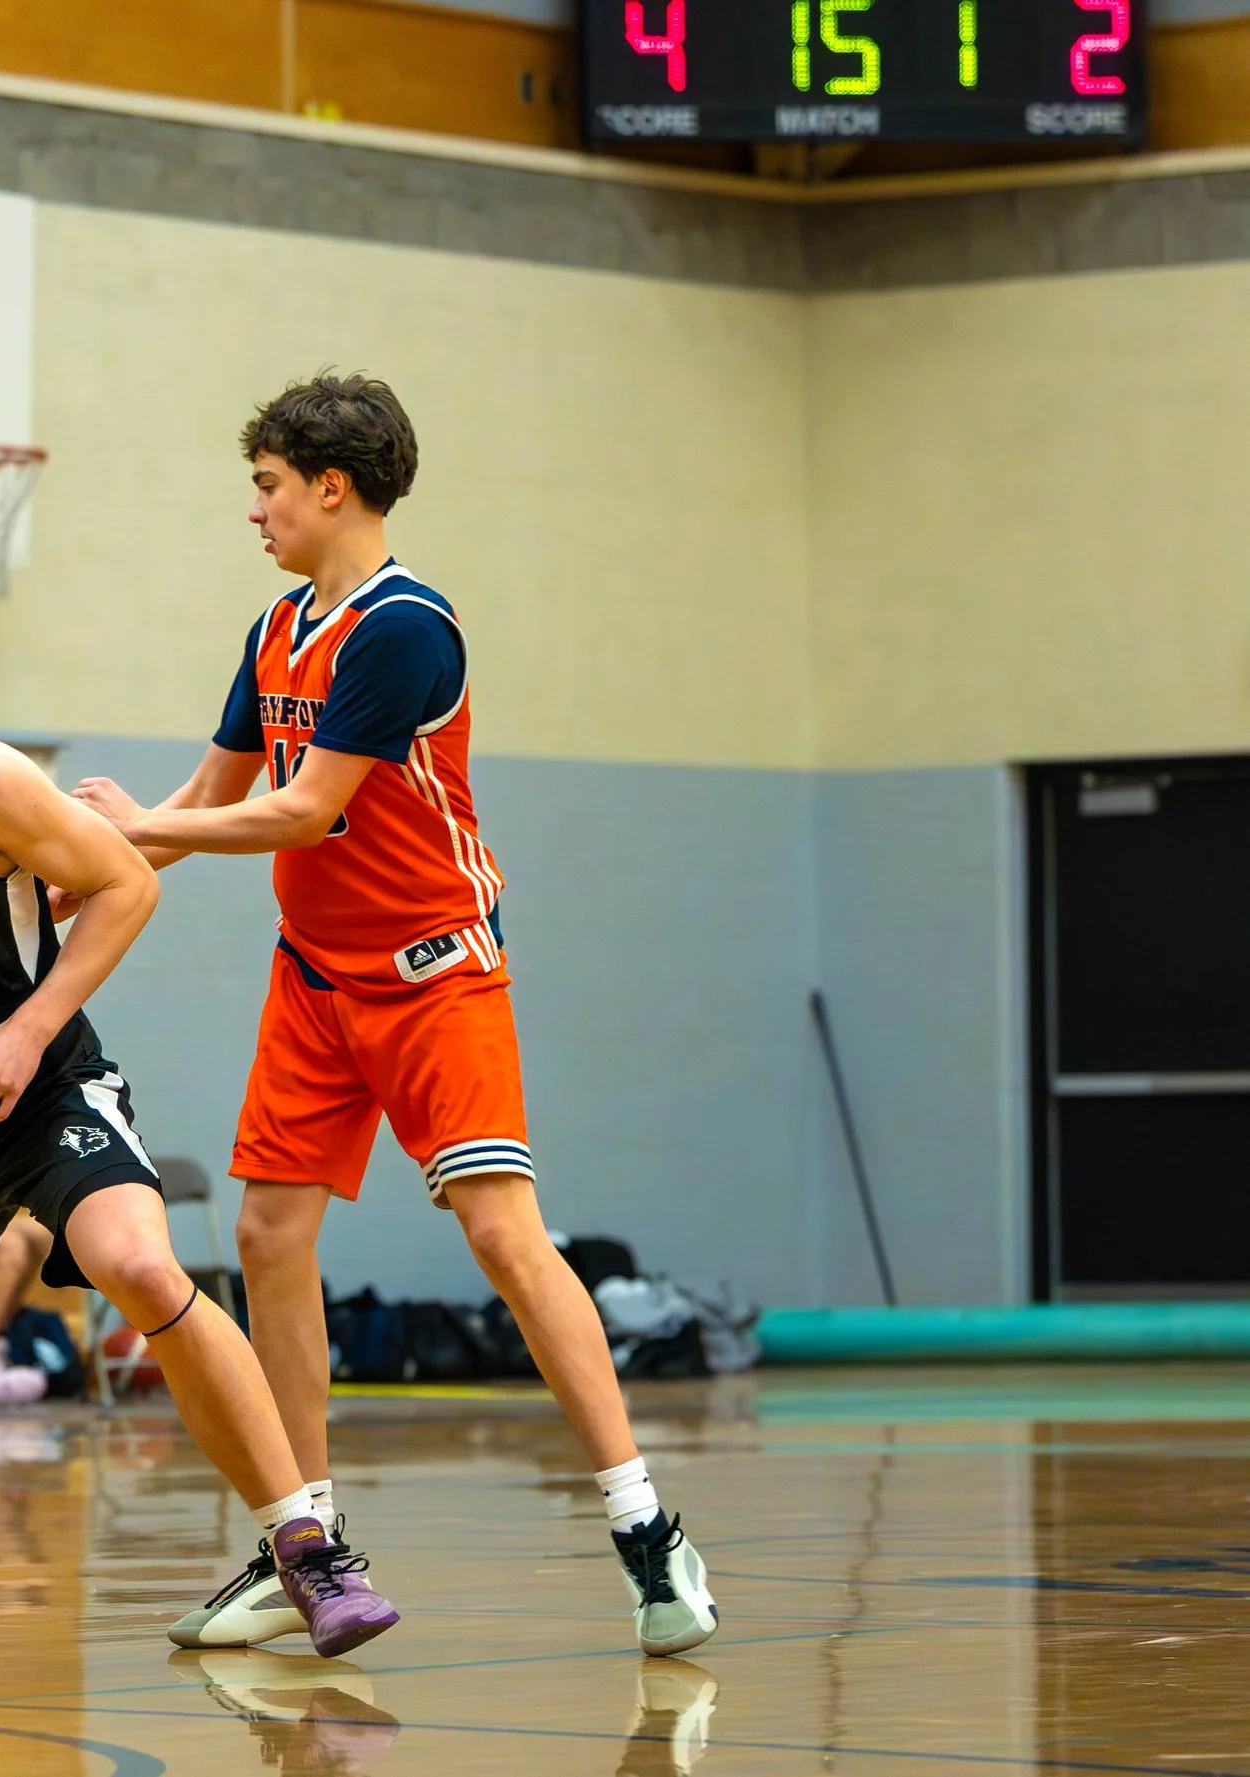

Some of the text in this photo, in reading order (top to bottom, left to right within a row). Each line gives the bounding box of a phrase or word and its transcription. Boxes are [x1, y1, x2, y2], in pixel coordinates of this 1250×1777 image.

[625, 0, 686, 92] 4
[792, 0, 881, 95] 15
[959, 0, 977, 91] 1
[1069, 0, 1130, 94] 2
[775, 103, 881, 136] MATCH
[1025, 102, 1127, 135] SCORE
